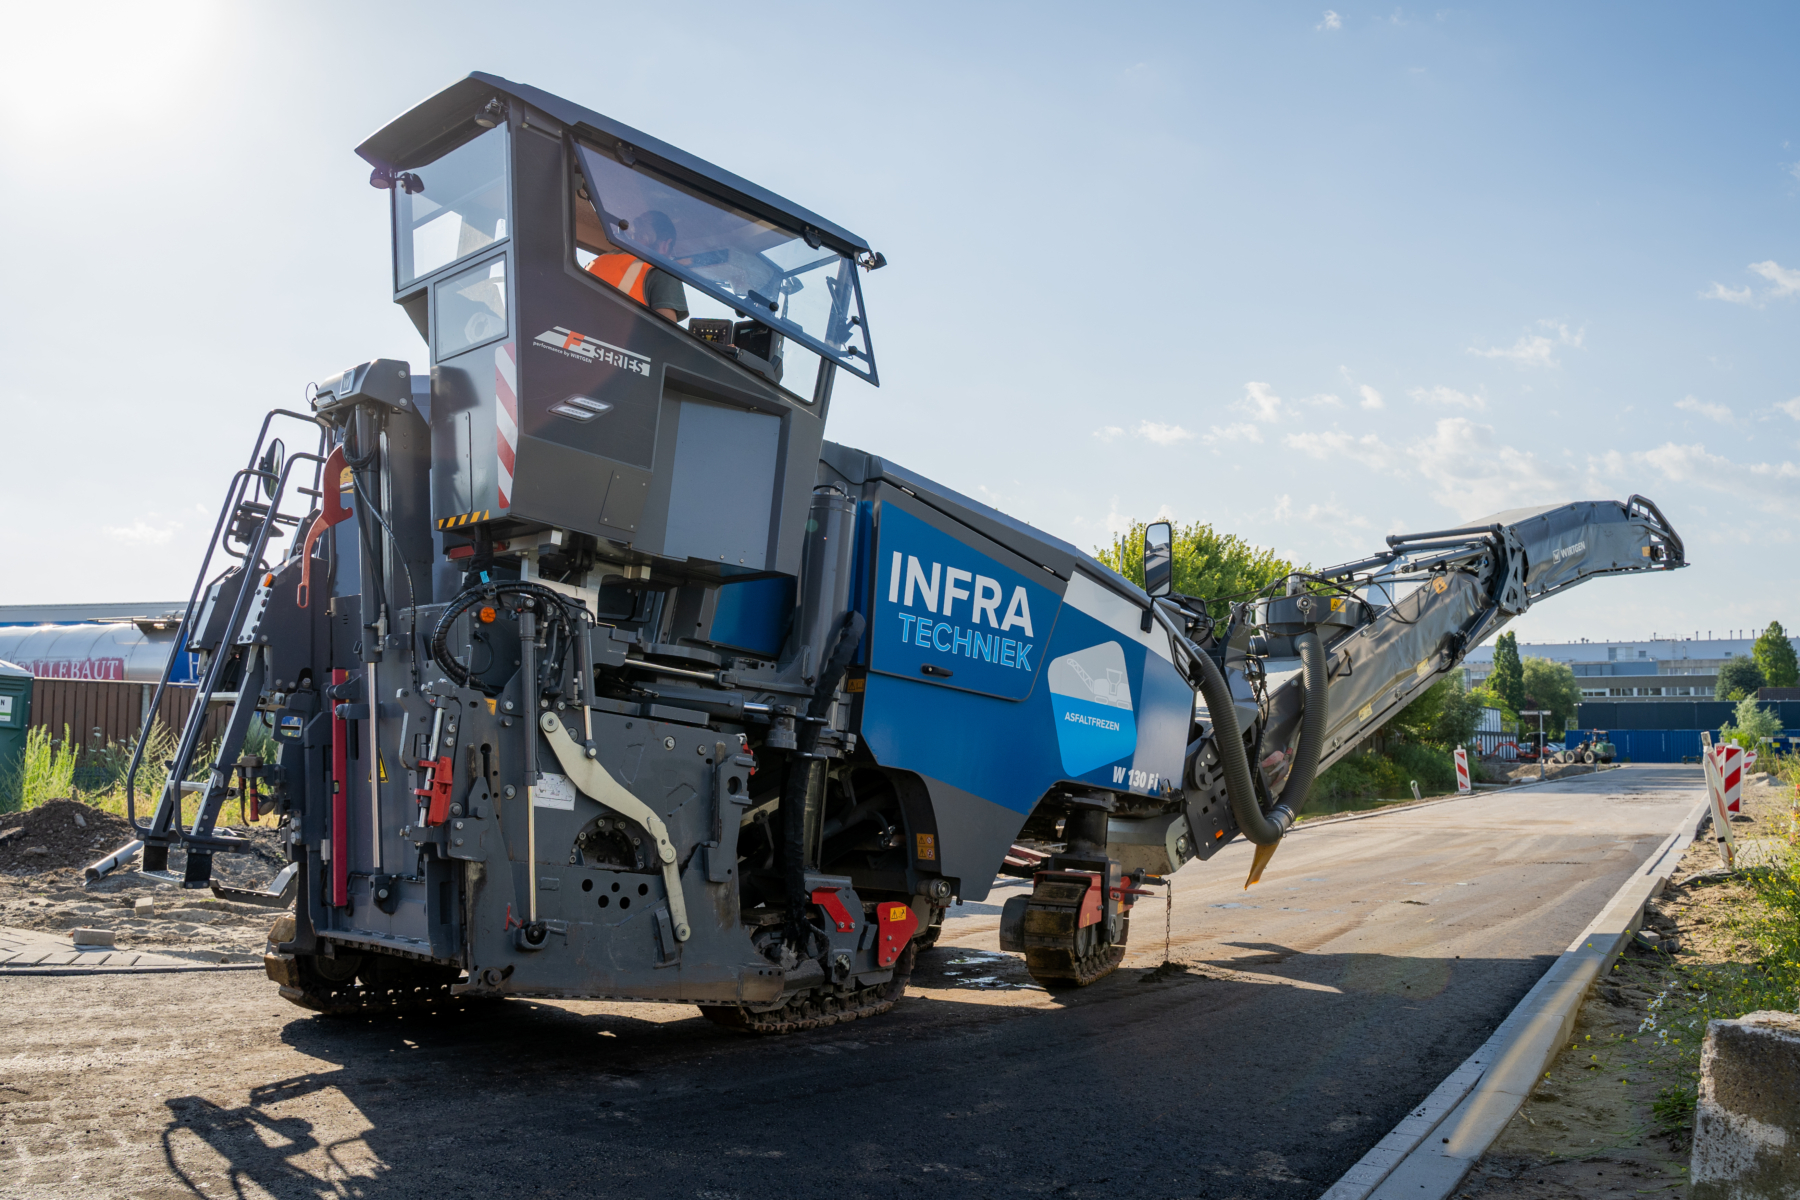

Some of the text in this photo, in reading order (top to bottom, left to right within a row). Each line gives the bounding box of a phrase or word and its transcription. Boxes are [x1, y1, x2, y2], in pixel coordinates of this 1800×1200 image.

[533, 341, 563, 354] performance
[570, 352, 592, 364] WIRTGEN
[1560, 541, 1586, 559] WIRTGEN
[889, 551, 1034, 638] INFRA
[898, 612, 1033, 672] TECHNIEK
[1064, 711, 1120, 732] ASFALTFREZEN
[1112, 765, 1159, 791] W 130 Fi
